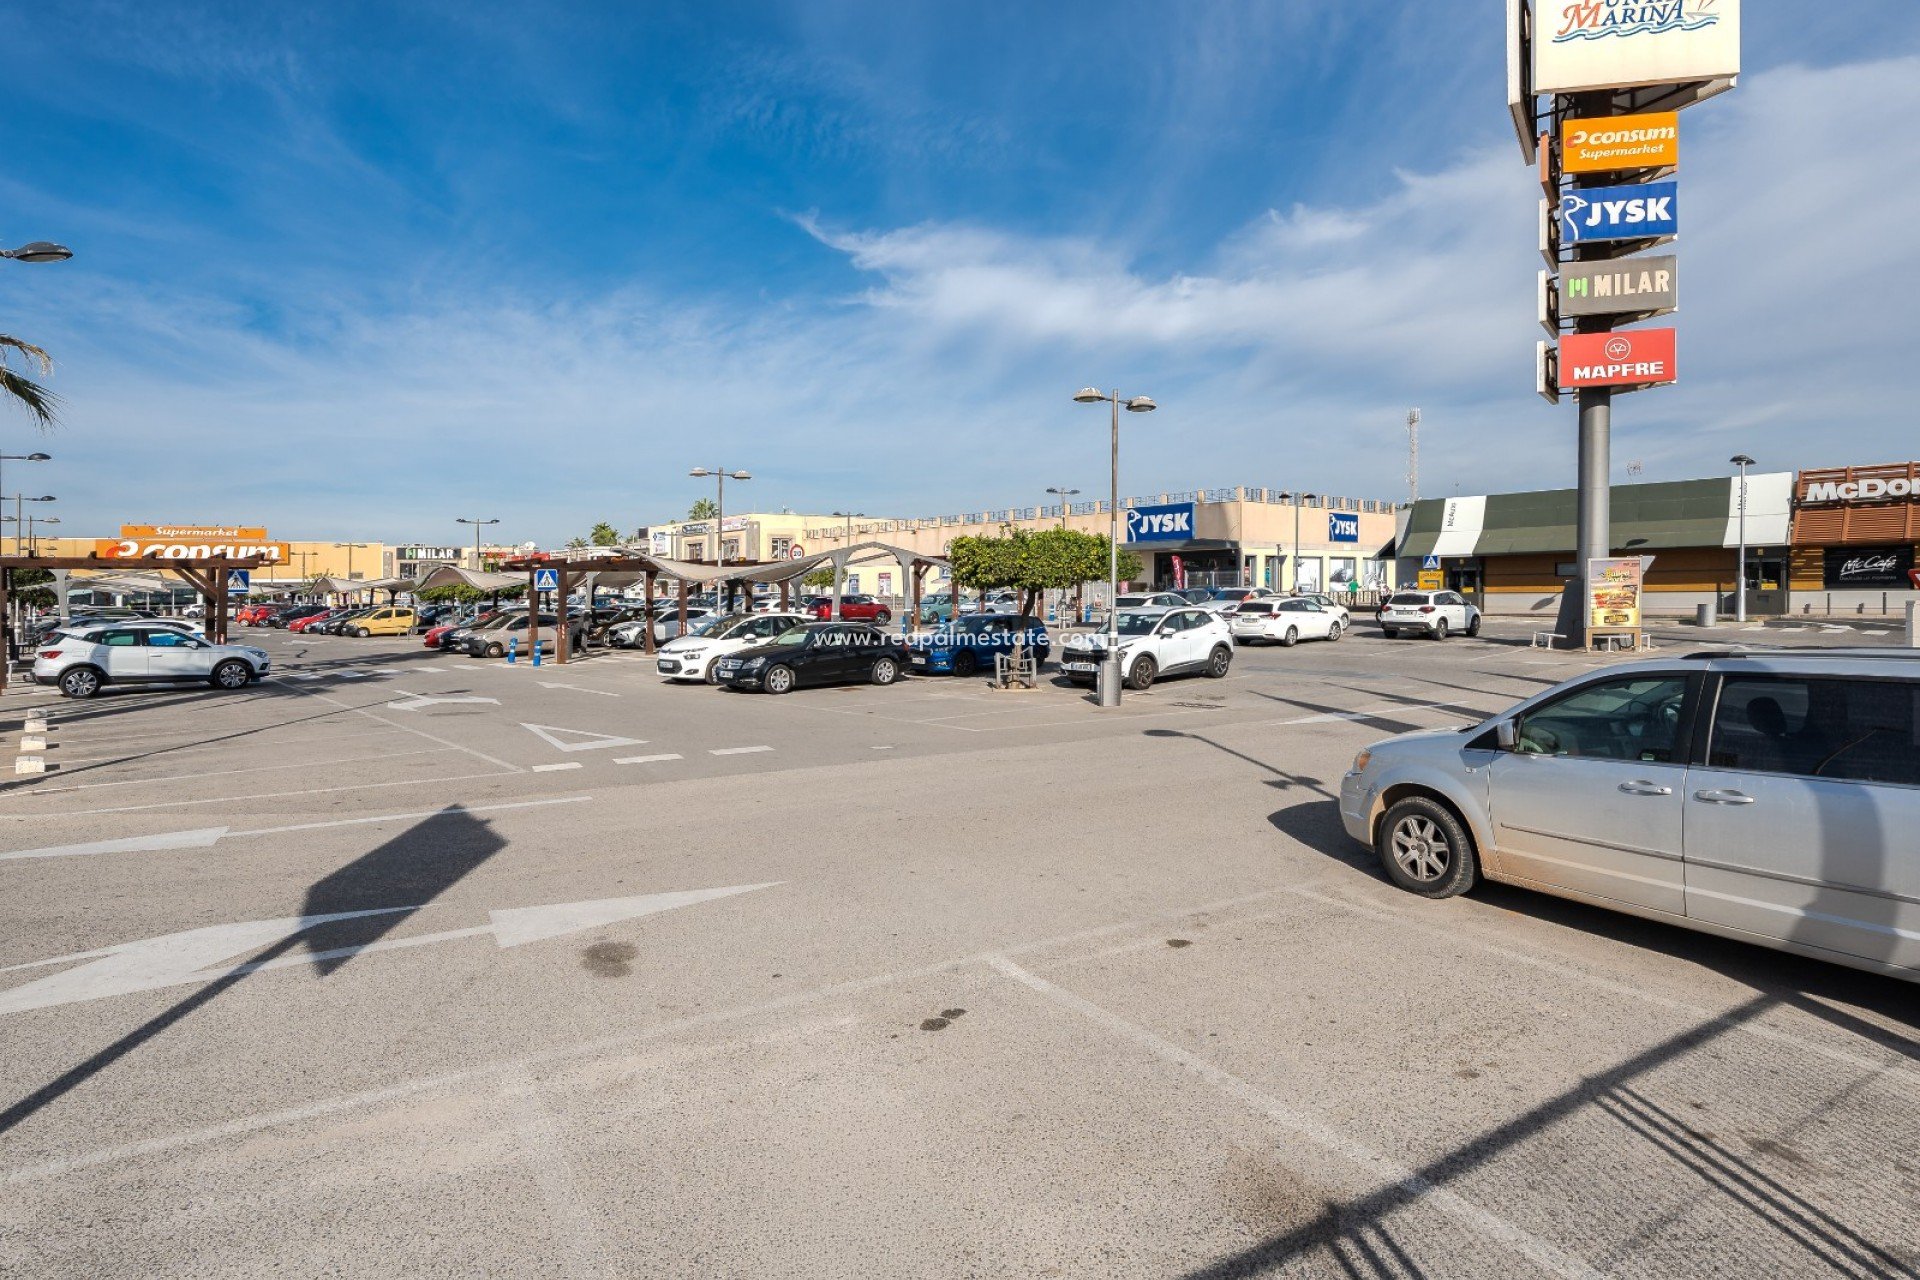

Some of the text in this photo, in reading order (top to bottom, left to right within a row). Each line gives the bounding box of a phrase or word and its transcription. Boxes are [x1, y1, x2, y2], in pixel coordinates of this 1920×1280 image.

[1557, 1, 1684, 35] MARINA
[1589, 126, 1676, 145] consum
[1579, 143, 1664, 160] Supermarket
[1585, 197, 1672, 226] JYSK
[1594, 270, 1670, 297] MILAR
[1573, 361, 1664, 380] MAPFRE
[155, 526, 238, 538] Supermarket
[1139, 512, 1190, 534] JYSK
[1335, 519, 1358, 535] JYSK
[143, 543, 280, 559] consum
[417, 548, 454, 559] MILAR
